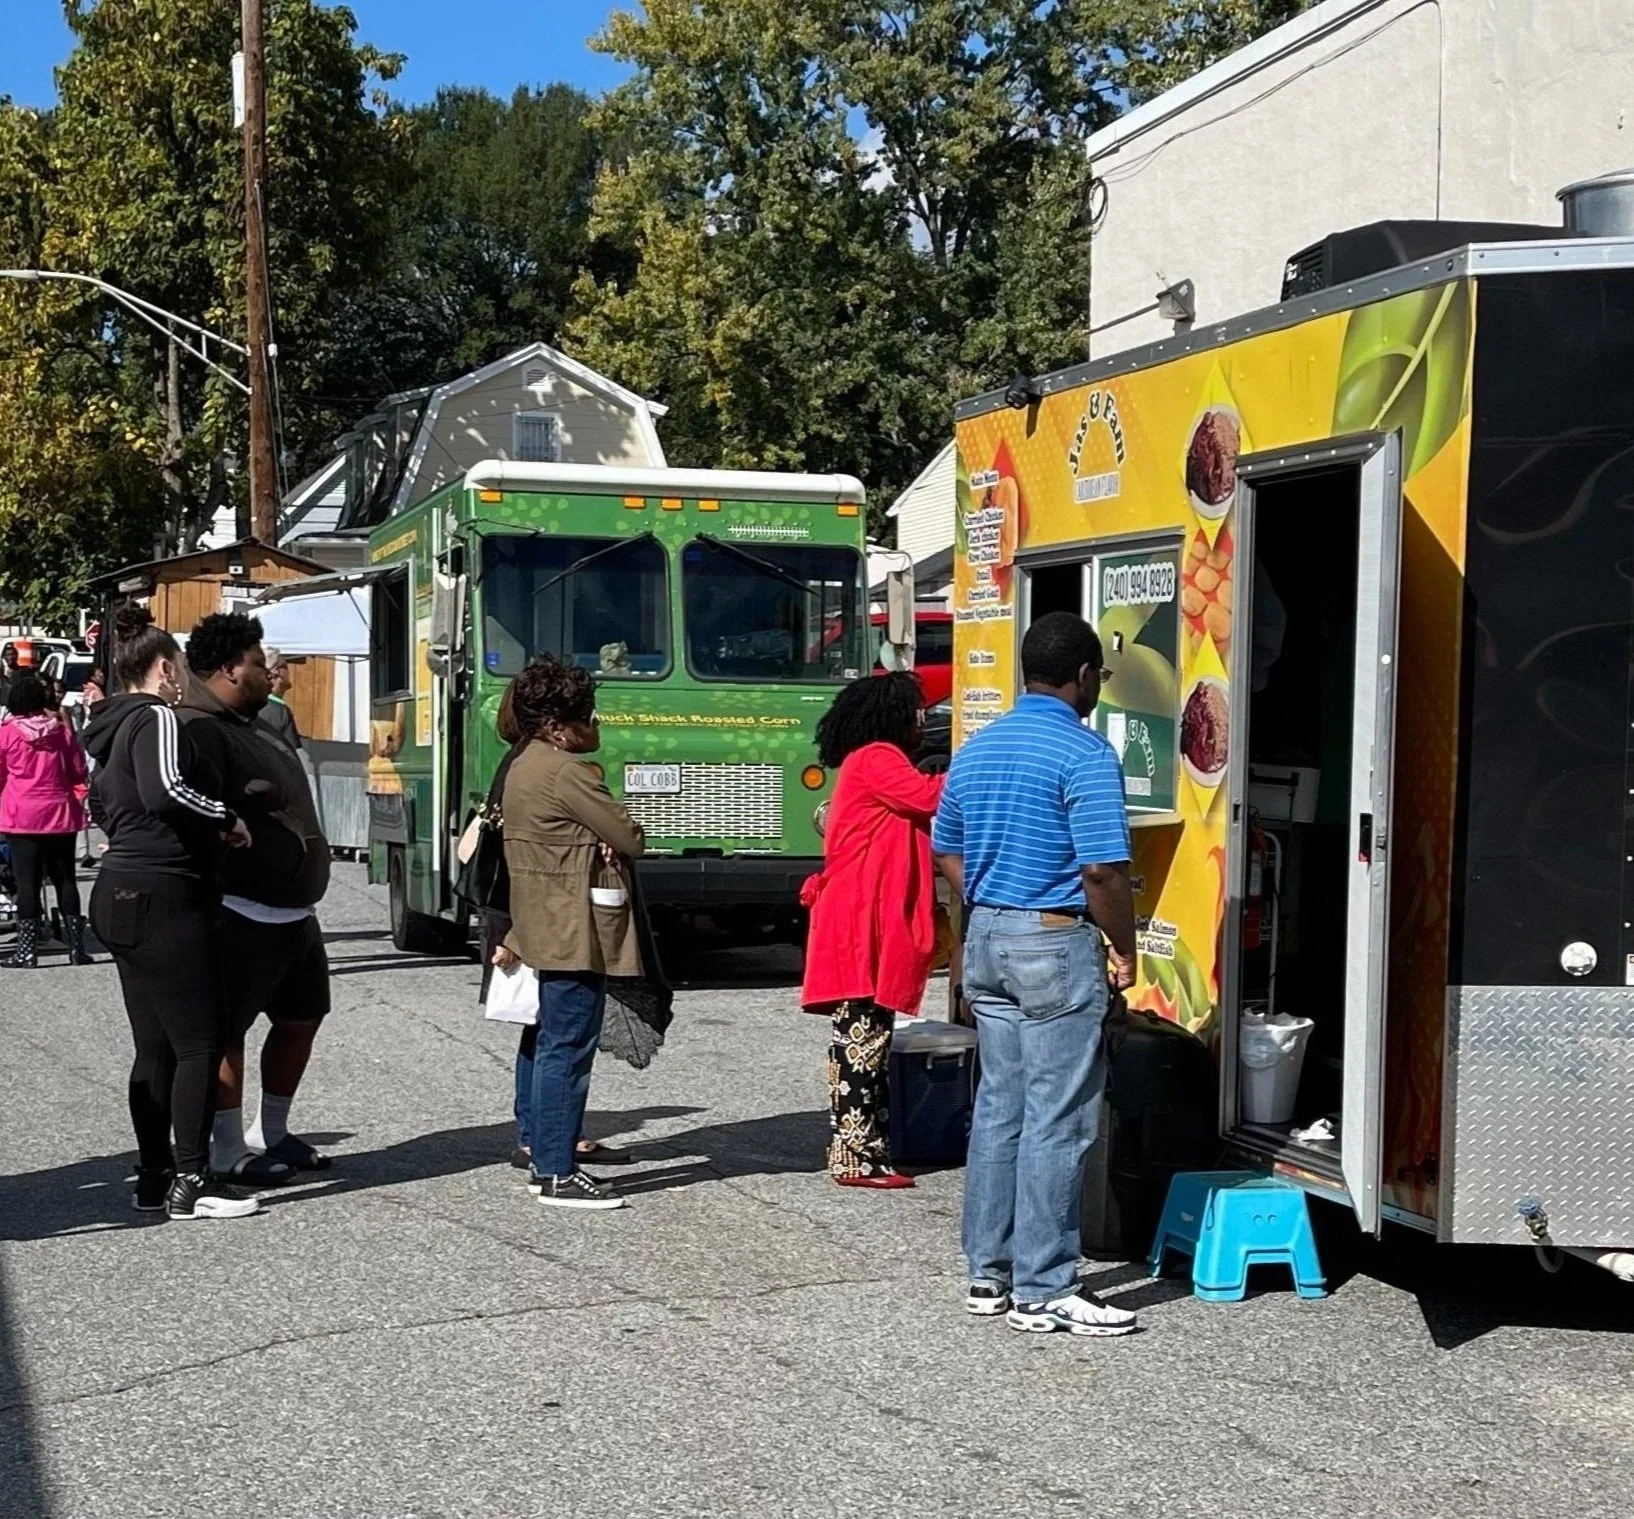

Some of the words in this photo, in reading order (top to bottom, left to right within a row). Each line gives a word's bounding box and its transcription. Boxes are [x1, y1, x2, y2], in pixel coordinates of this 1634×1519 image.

[1103, 392, 1125, 465] Fam
[1105, 569, 1129, 602] (240)
[1130, 570, 1148, 598] 994
[1149, 567, 1173, 597] 8928
[596, 713, 634, 722] huck
[638, 713, 688, 723] Shack
[691, 714, 756, 724] Roasted
[760, 716, 801, 725] Corn
[627, 772, 647, 786] COL
[650, 772, 678, 787] COBB
[1151, 920, 1177, 937] Salmon
